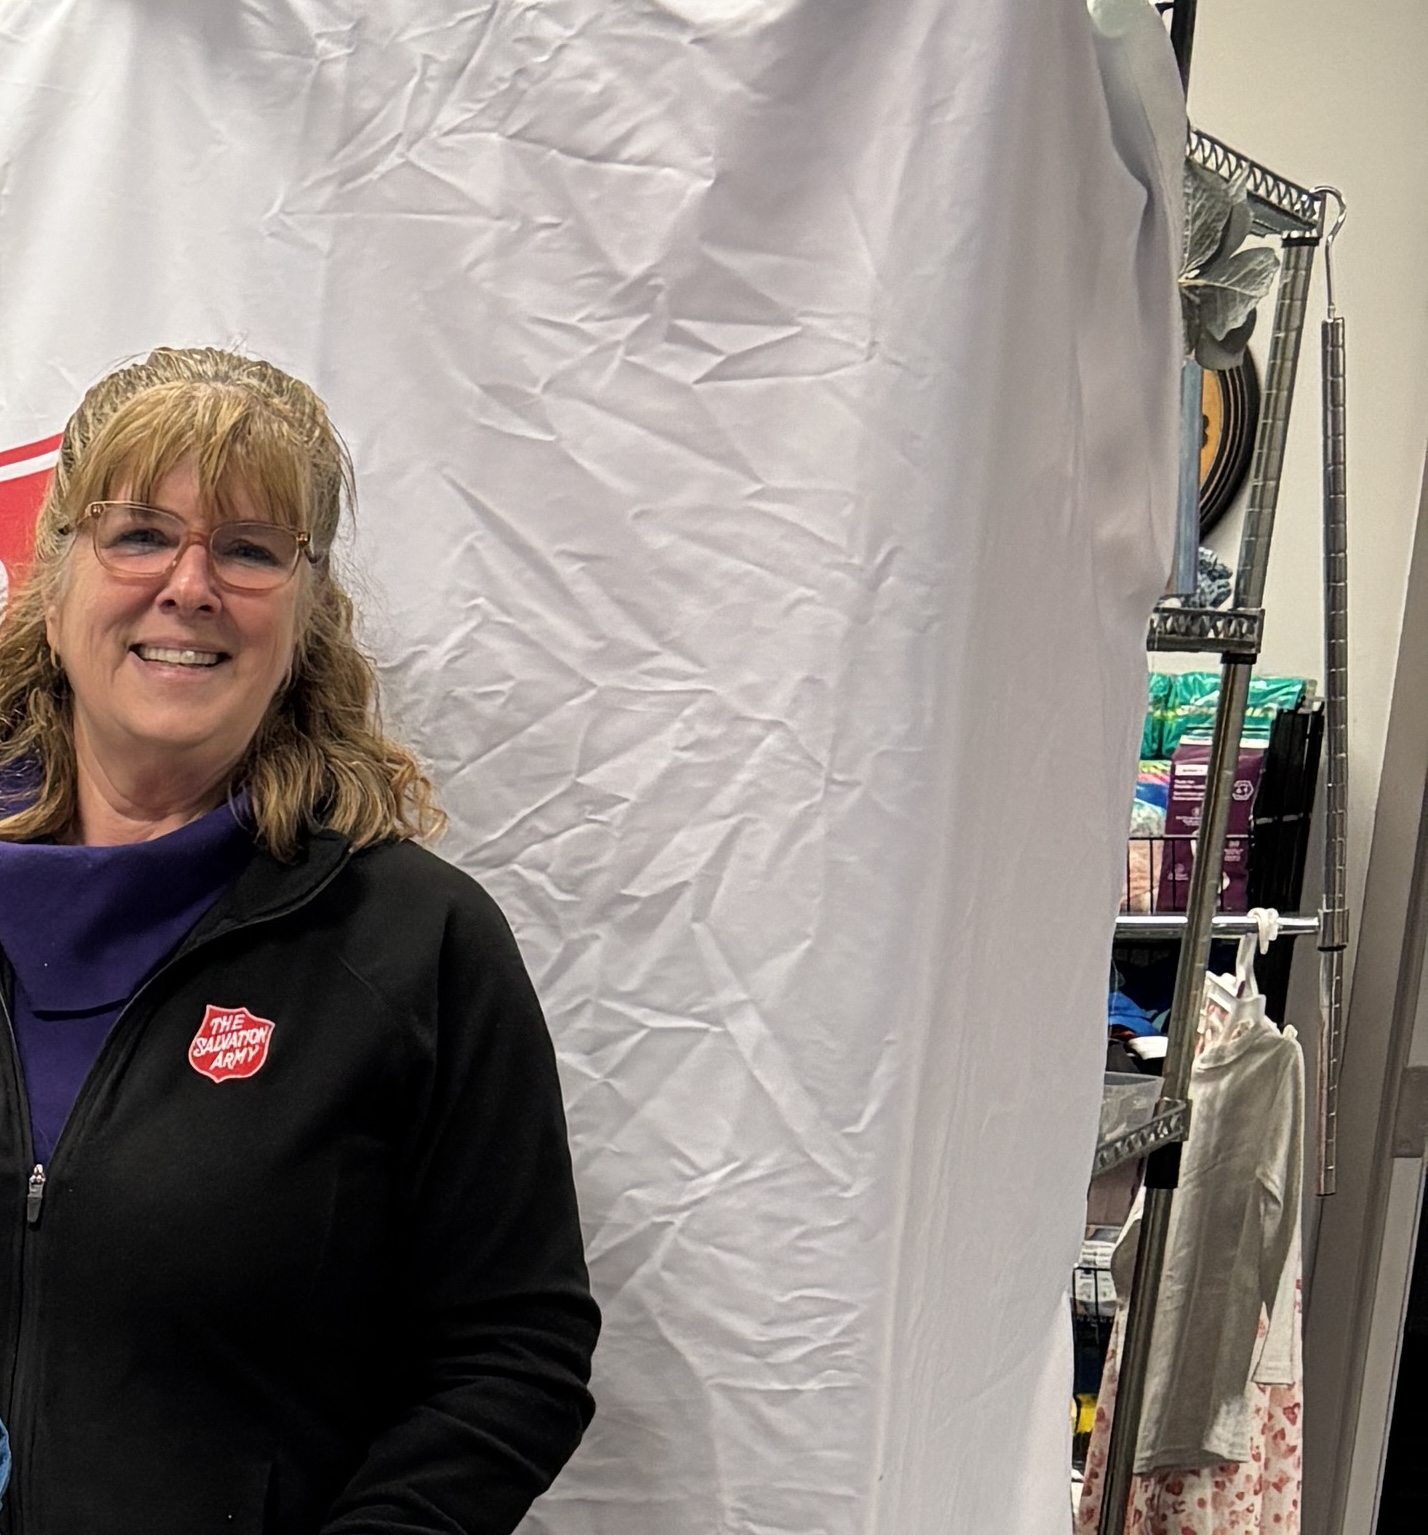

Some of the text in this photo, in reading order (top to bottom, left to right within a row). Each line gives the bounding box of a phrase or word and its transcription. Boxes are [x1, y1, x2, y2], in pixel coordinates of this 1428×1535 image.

[210, 1014, 245, 1034] THE
[193, 1026, 269, 1057] SALVATION
[209, 1045, 260, 1070] ARMY
